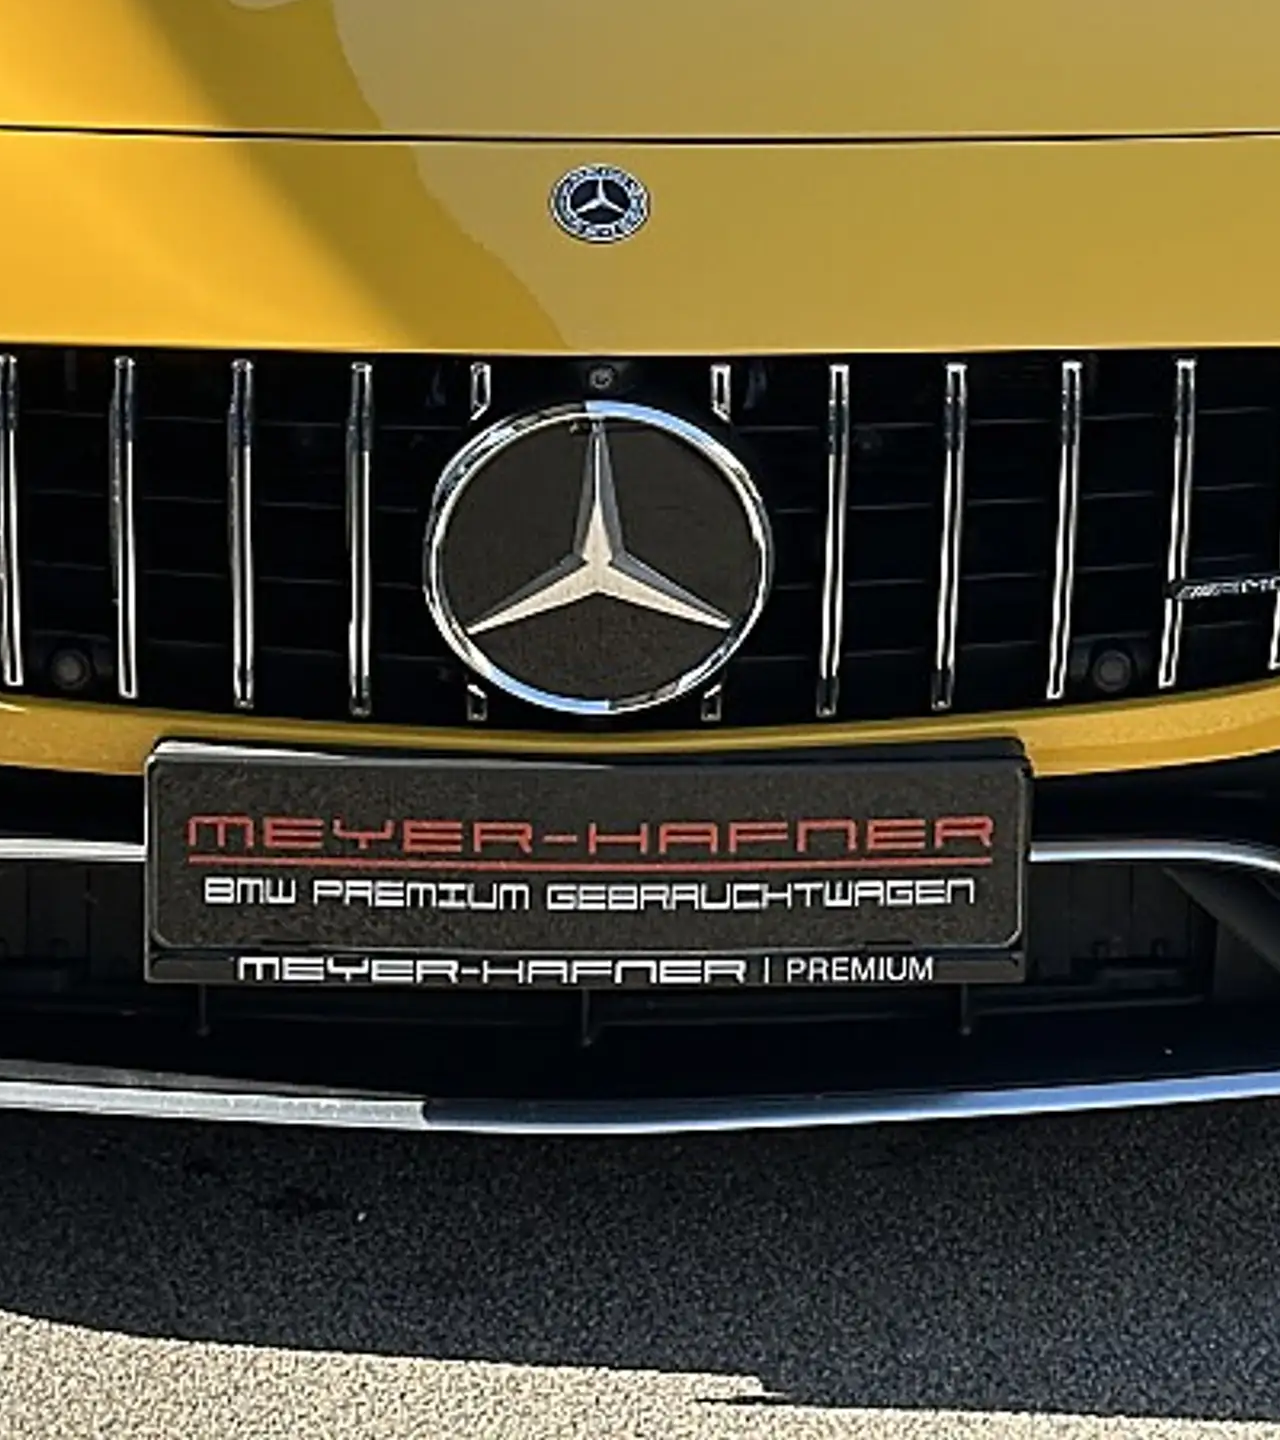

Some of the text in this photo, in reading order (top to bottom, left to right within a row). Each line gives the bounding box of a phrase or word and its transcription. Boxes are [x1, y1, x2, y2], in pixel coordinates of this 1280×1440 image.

[187, 814, 995, 857] MEYER-HAFNER
[204, 876, 976, 912] BMW PREMIUM GEBRAUCHTWAGEN
[237, 956, 935, 985] MEYER-HAFNER PREMIUM
